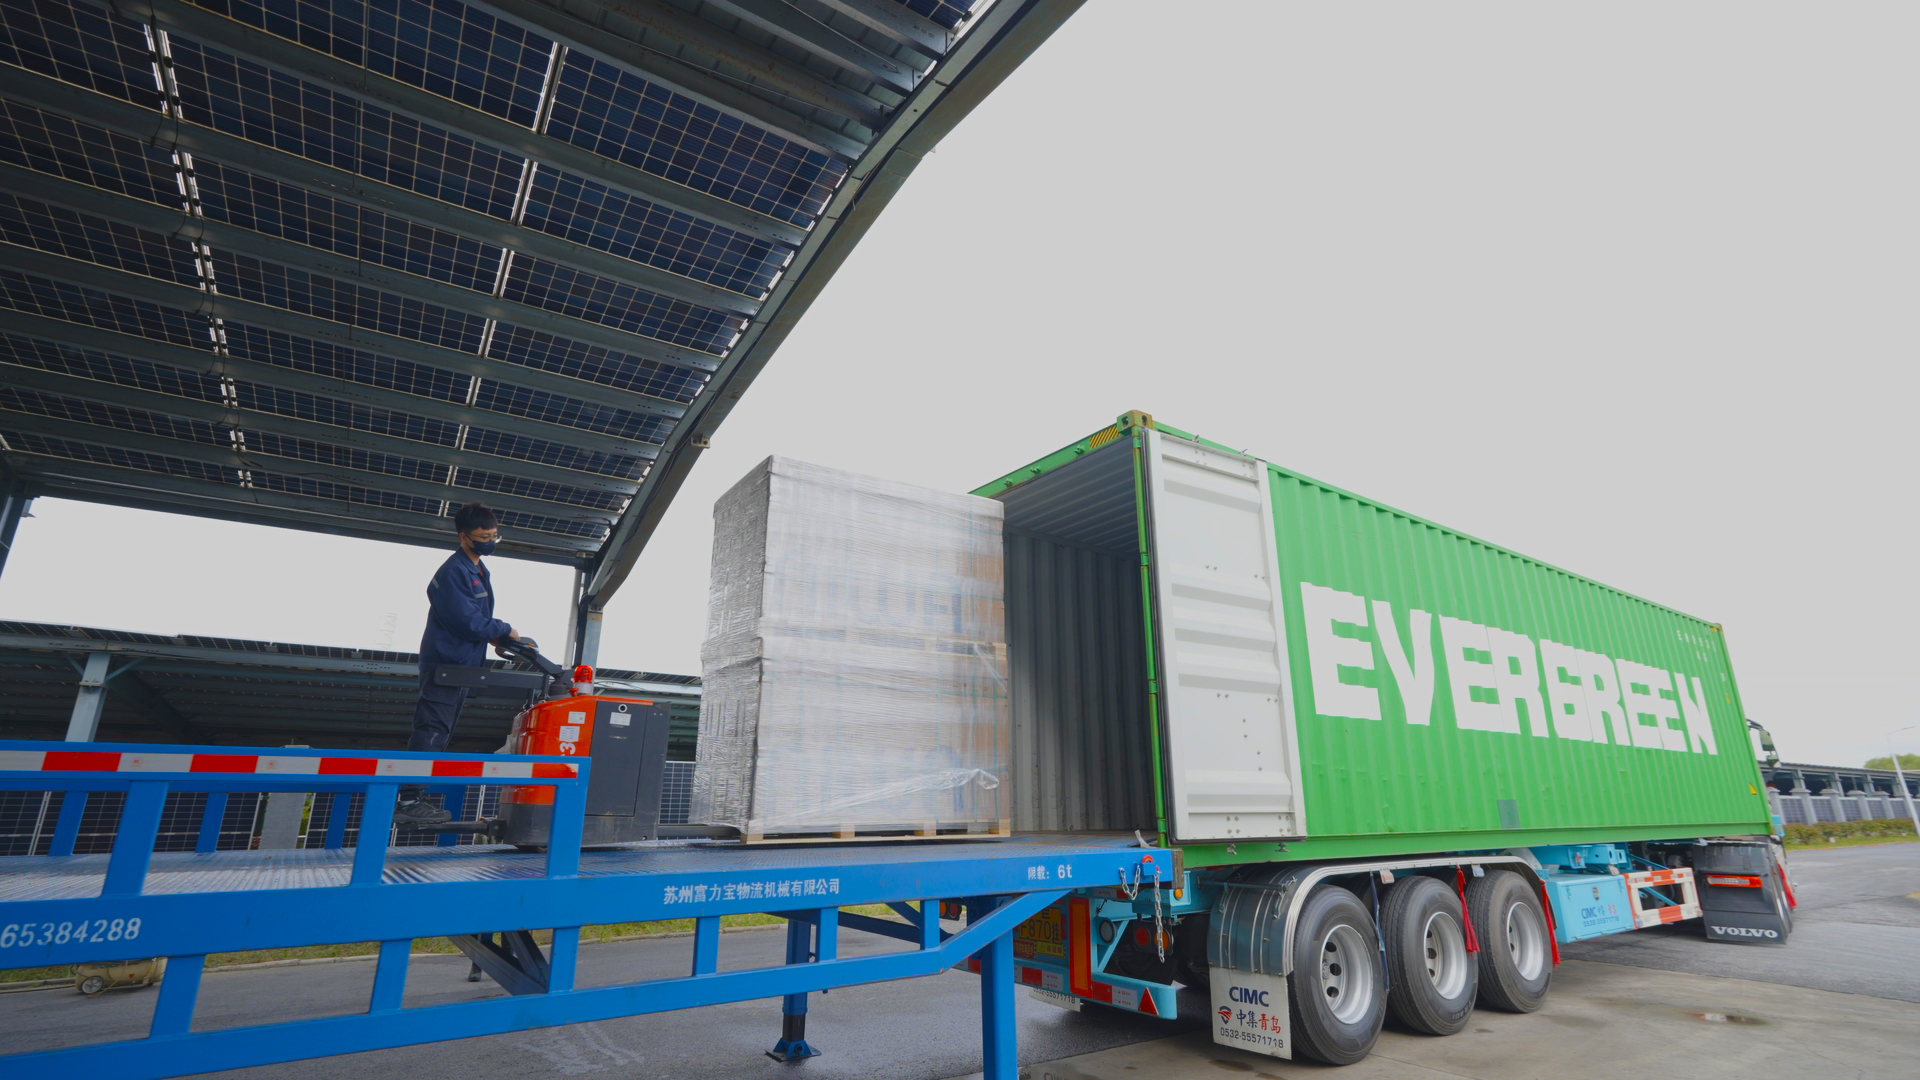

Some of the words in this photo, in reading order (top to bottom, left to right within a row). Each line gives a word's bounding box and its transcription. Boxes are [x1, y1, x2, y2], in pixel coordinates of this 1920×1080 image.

[1300, 582, 1718, 756] EVERGREEN
[1057, 864, 1073, 879] 6t
[663, 878, 840, 905] 苏州富力宝物流机械有限公司
[1581, 906, 1598, 920] CIMC
[0, 917, 142, 948] 65384288
[1711, 925, 1778, 938] VOLVO
[1228, 986, 1270, 1008] CIMC
[1236, 1008, 1282, 1035] 中集青岛
[1220, 1027, 1284, 1049] 0532-55571718
